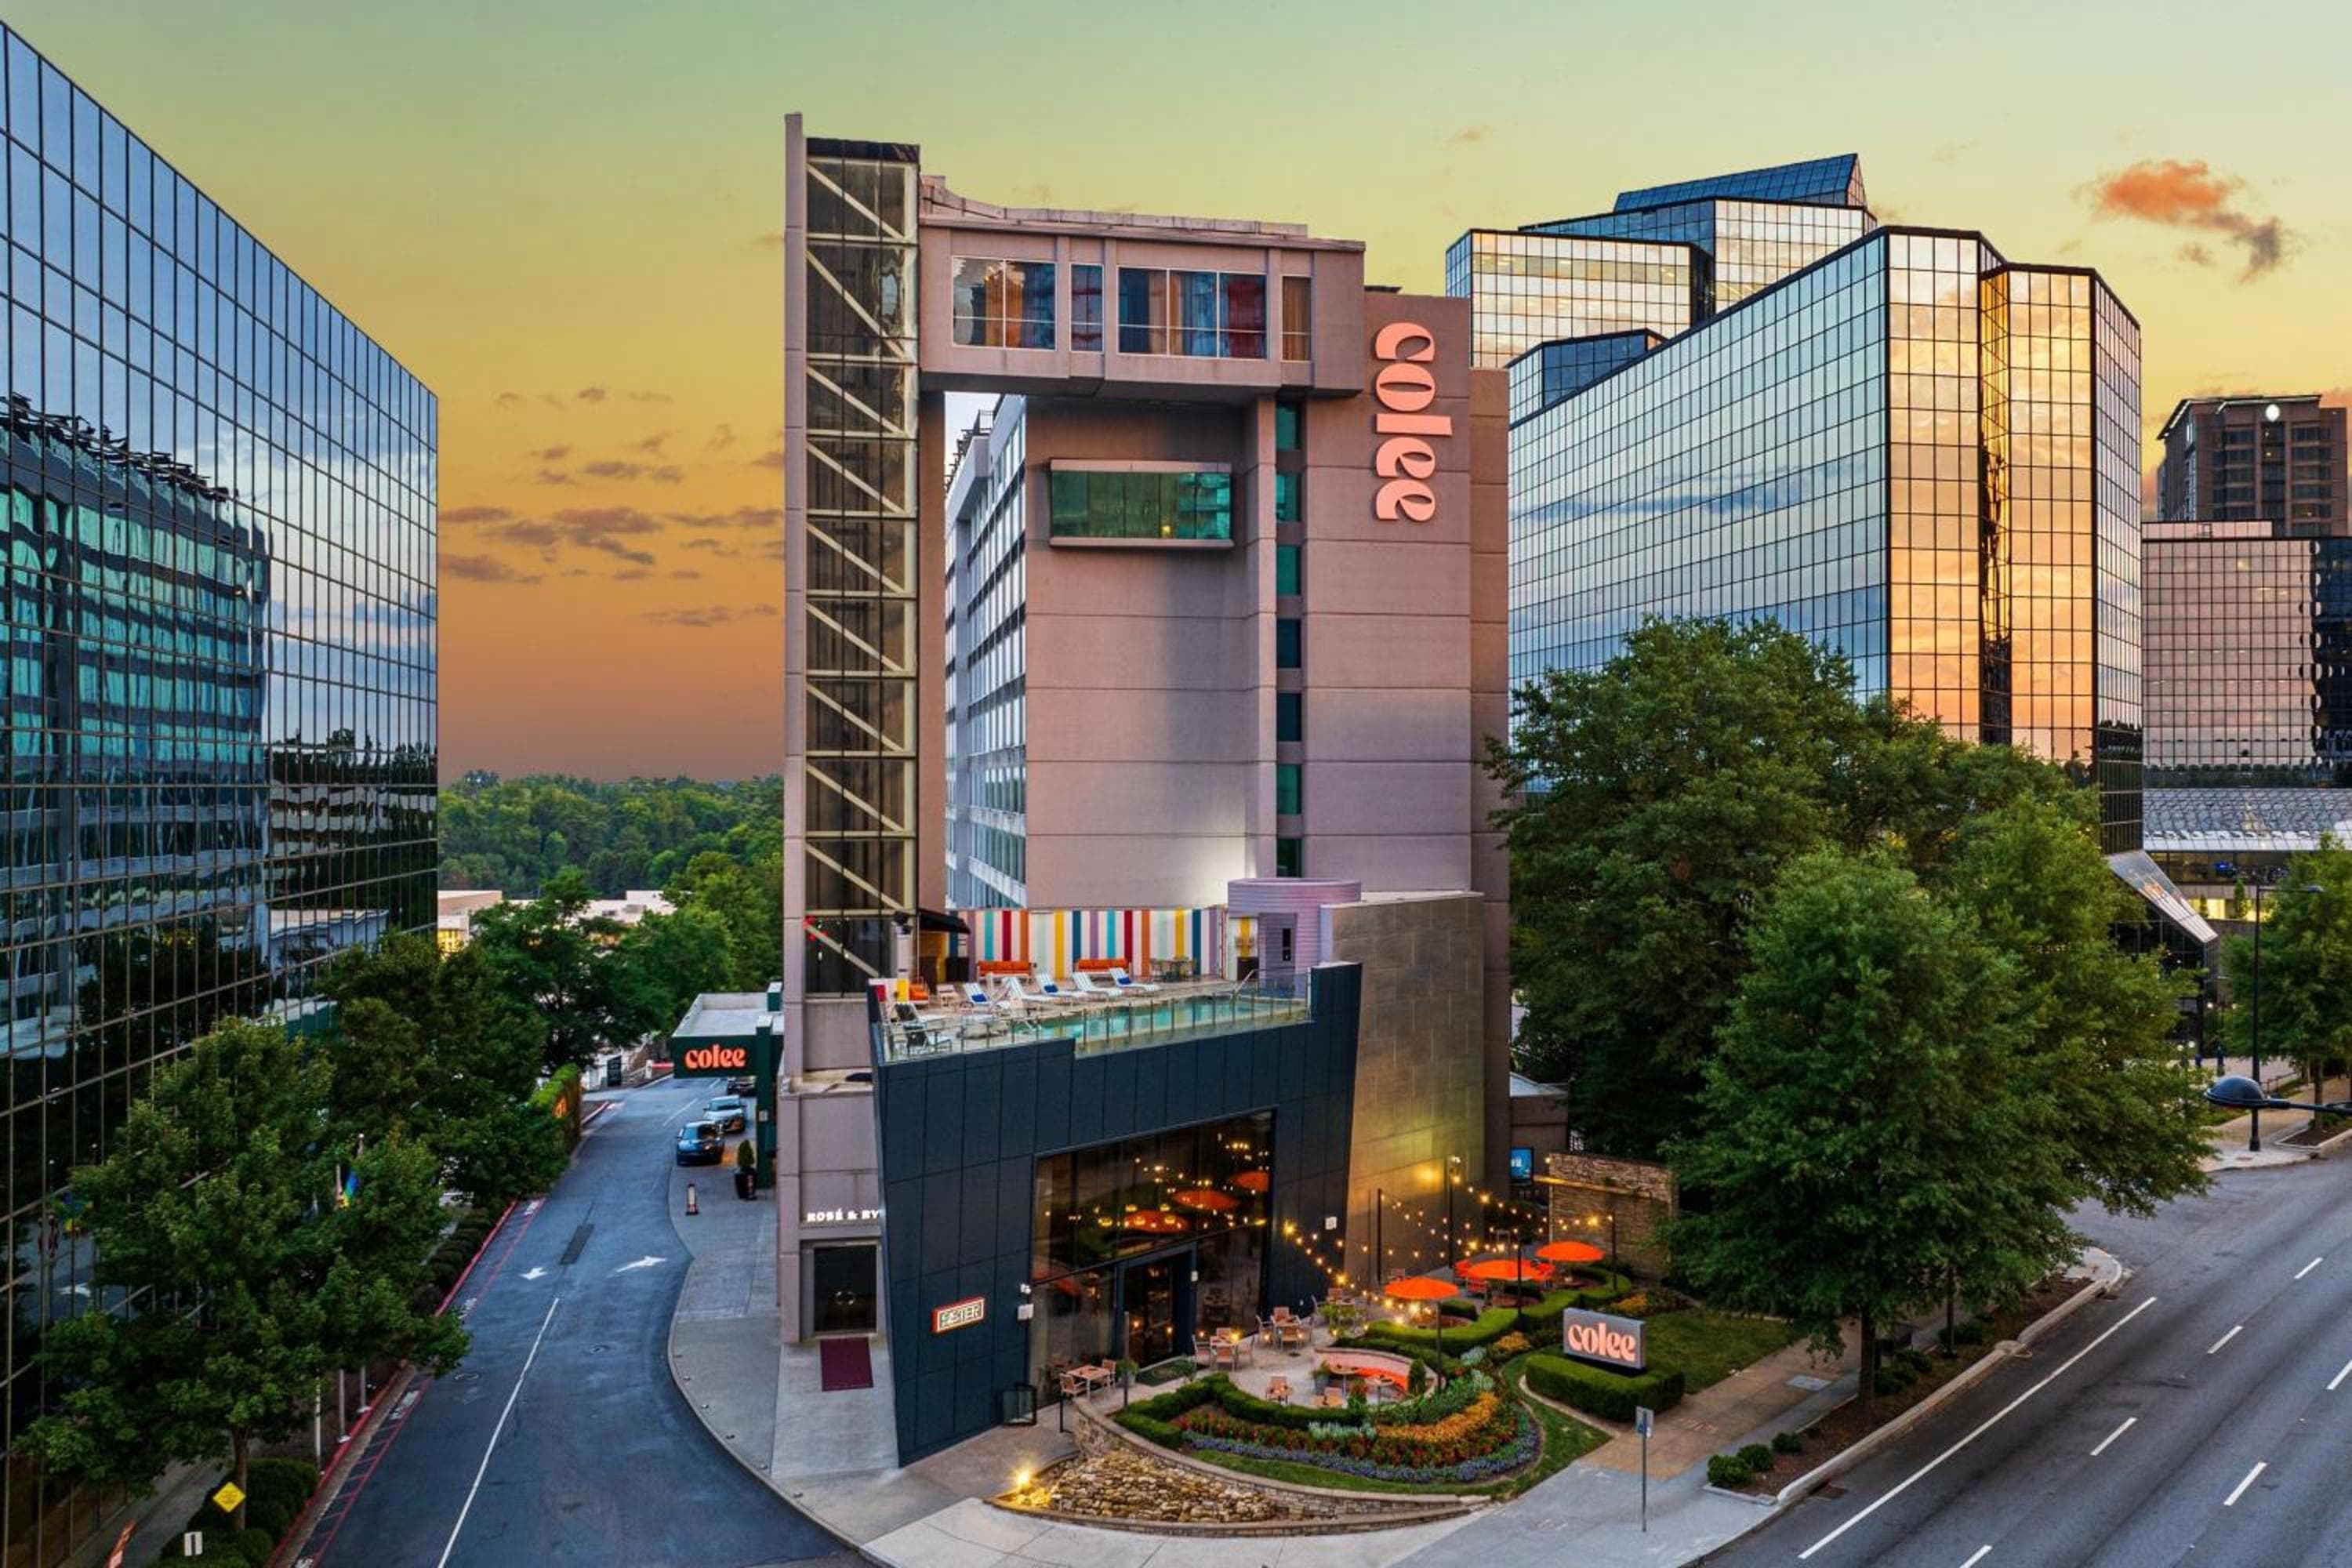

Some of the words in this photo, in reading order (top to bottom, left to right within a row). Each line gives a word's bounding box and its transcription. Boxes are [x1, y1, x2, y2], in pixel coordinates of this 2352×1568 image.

[1375, 322, 1452, 522] colee
[685, 1044, 746, 1069] colee
[848, 1210, 858, 1221] &
[862, 1210, 881, 1220] RY
[1568, 1323, 1635, 1361] colee
